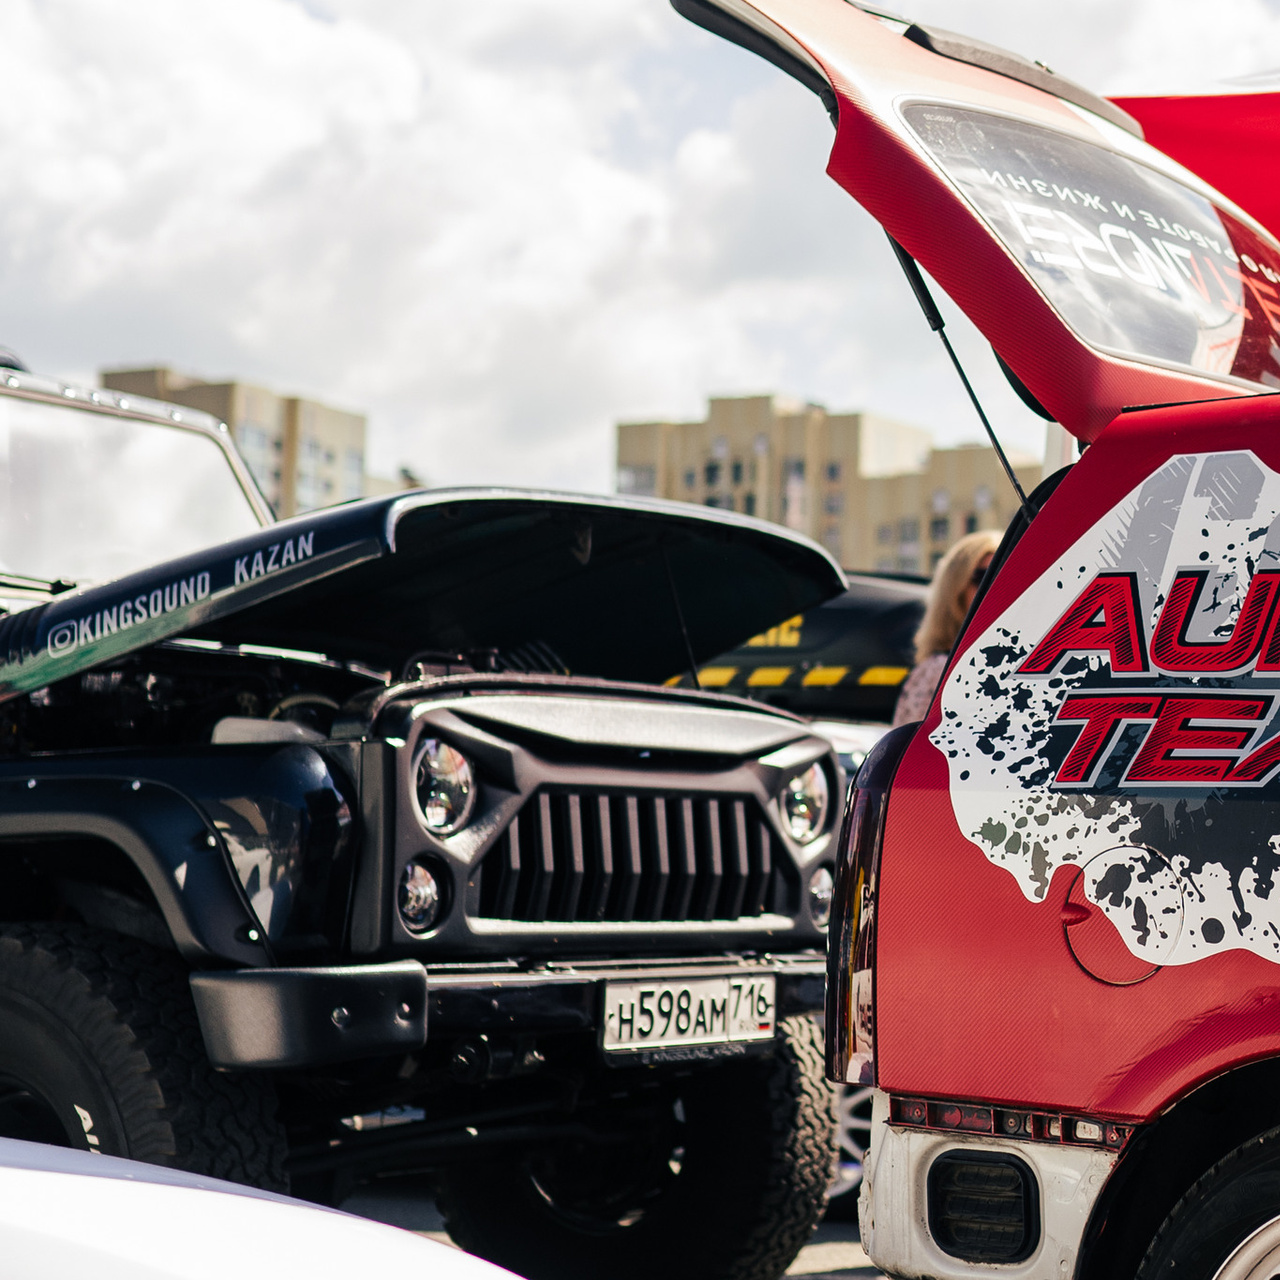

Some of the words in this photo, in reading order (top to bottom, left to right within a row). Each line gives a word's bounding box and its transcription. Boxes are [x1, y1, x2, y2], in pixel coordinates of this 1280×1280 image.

[983, 167, 1108, 209] ЖИЗНИ
[1109, 198, 1136, 221] И
[1136, 208, 1240, 263] РАБОТЕ
